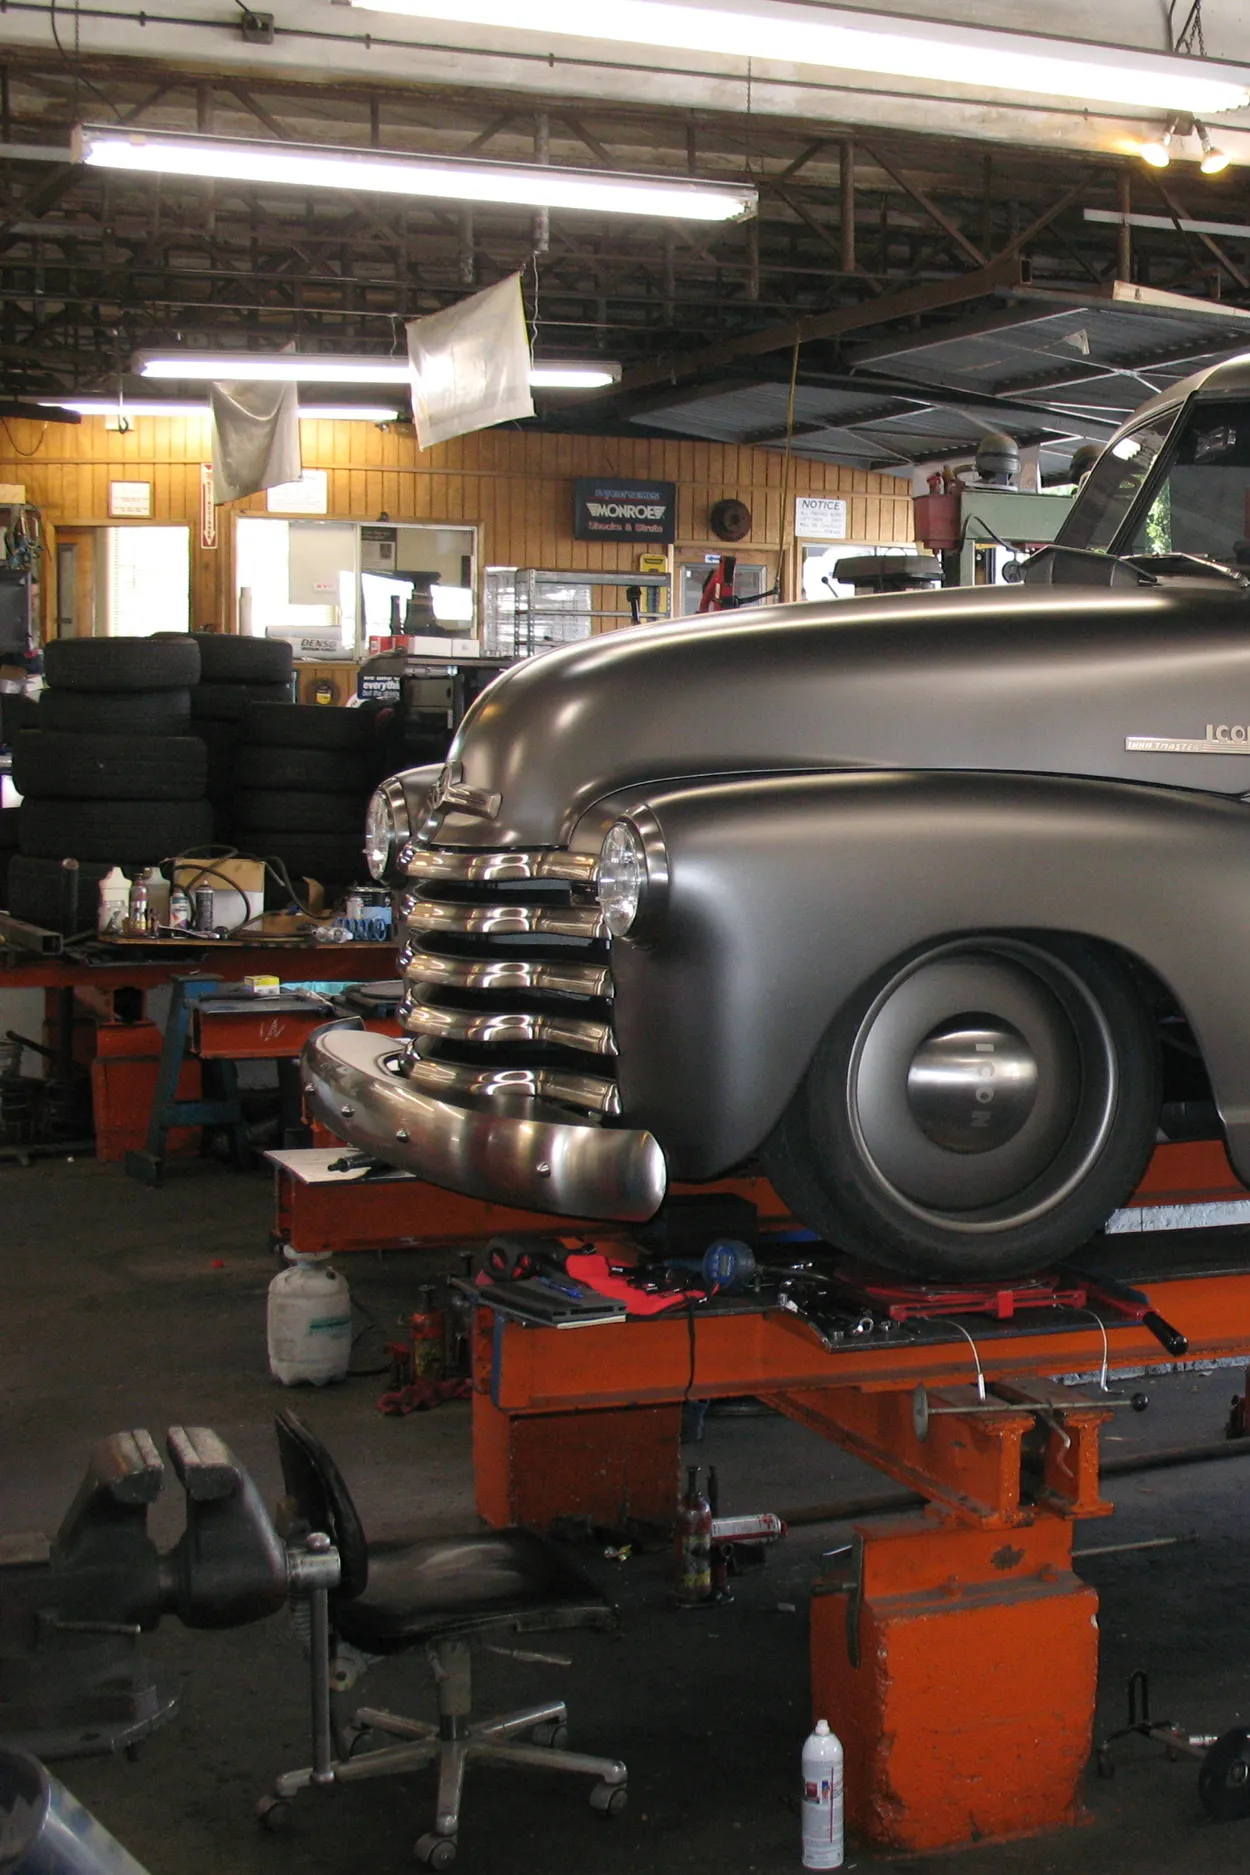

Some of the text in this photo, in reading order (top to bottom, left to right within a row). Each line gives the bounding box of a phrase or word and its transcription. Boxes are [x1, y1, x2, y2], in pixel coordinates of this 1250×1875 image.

[801, 500, 840, 510] NOTICE
[597, 503, 658, 519] MONROE
[588, 521, 622, 531] Shocks
[301, 639, 337, 648] DENSO
[363, 681, 400, 691] everythi
